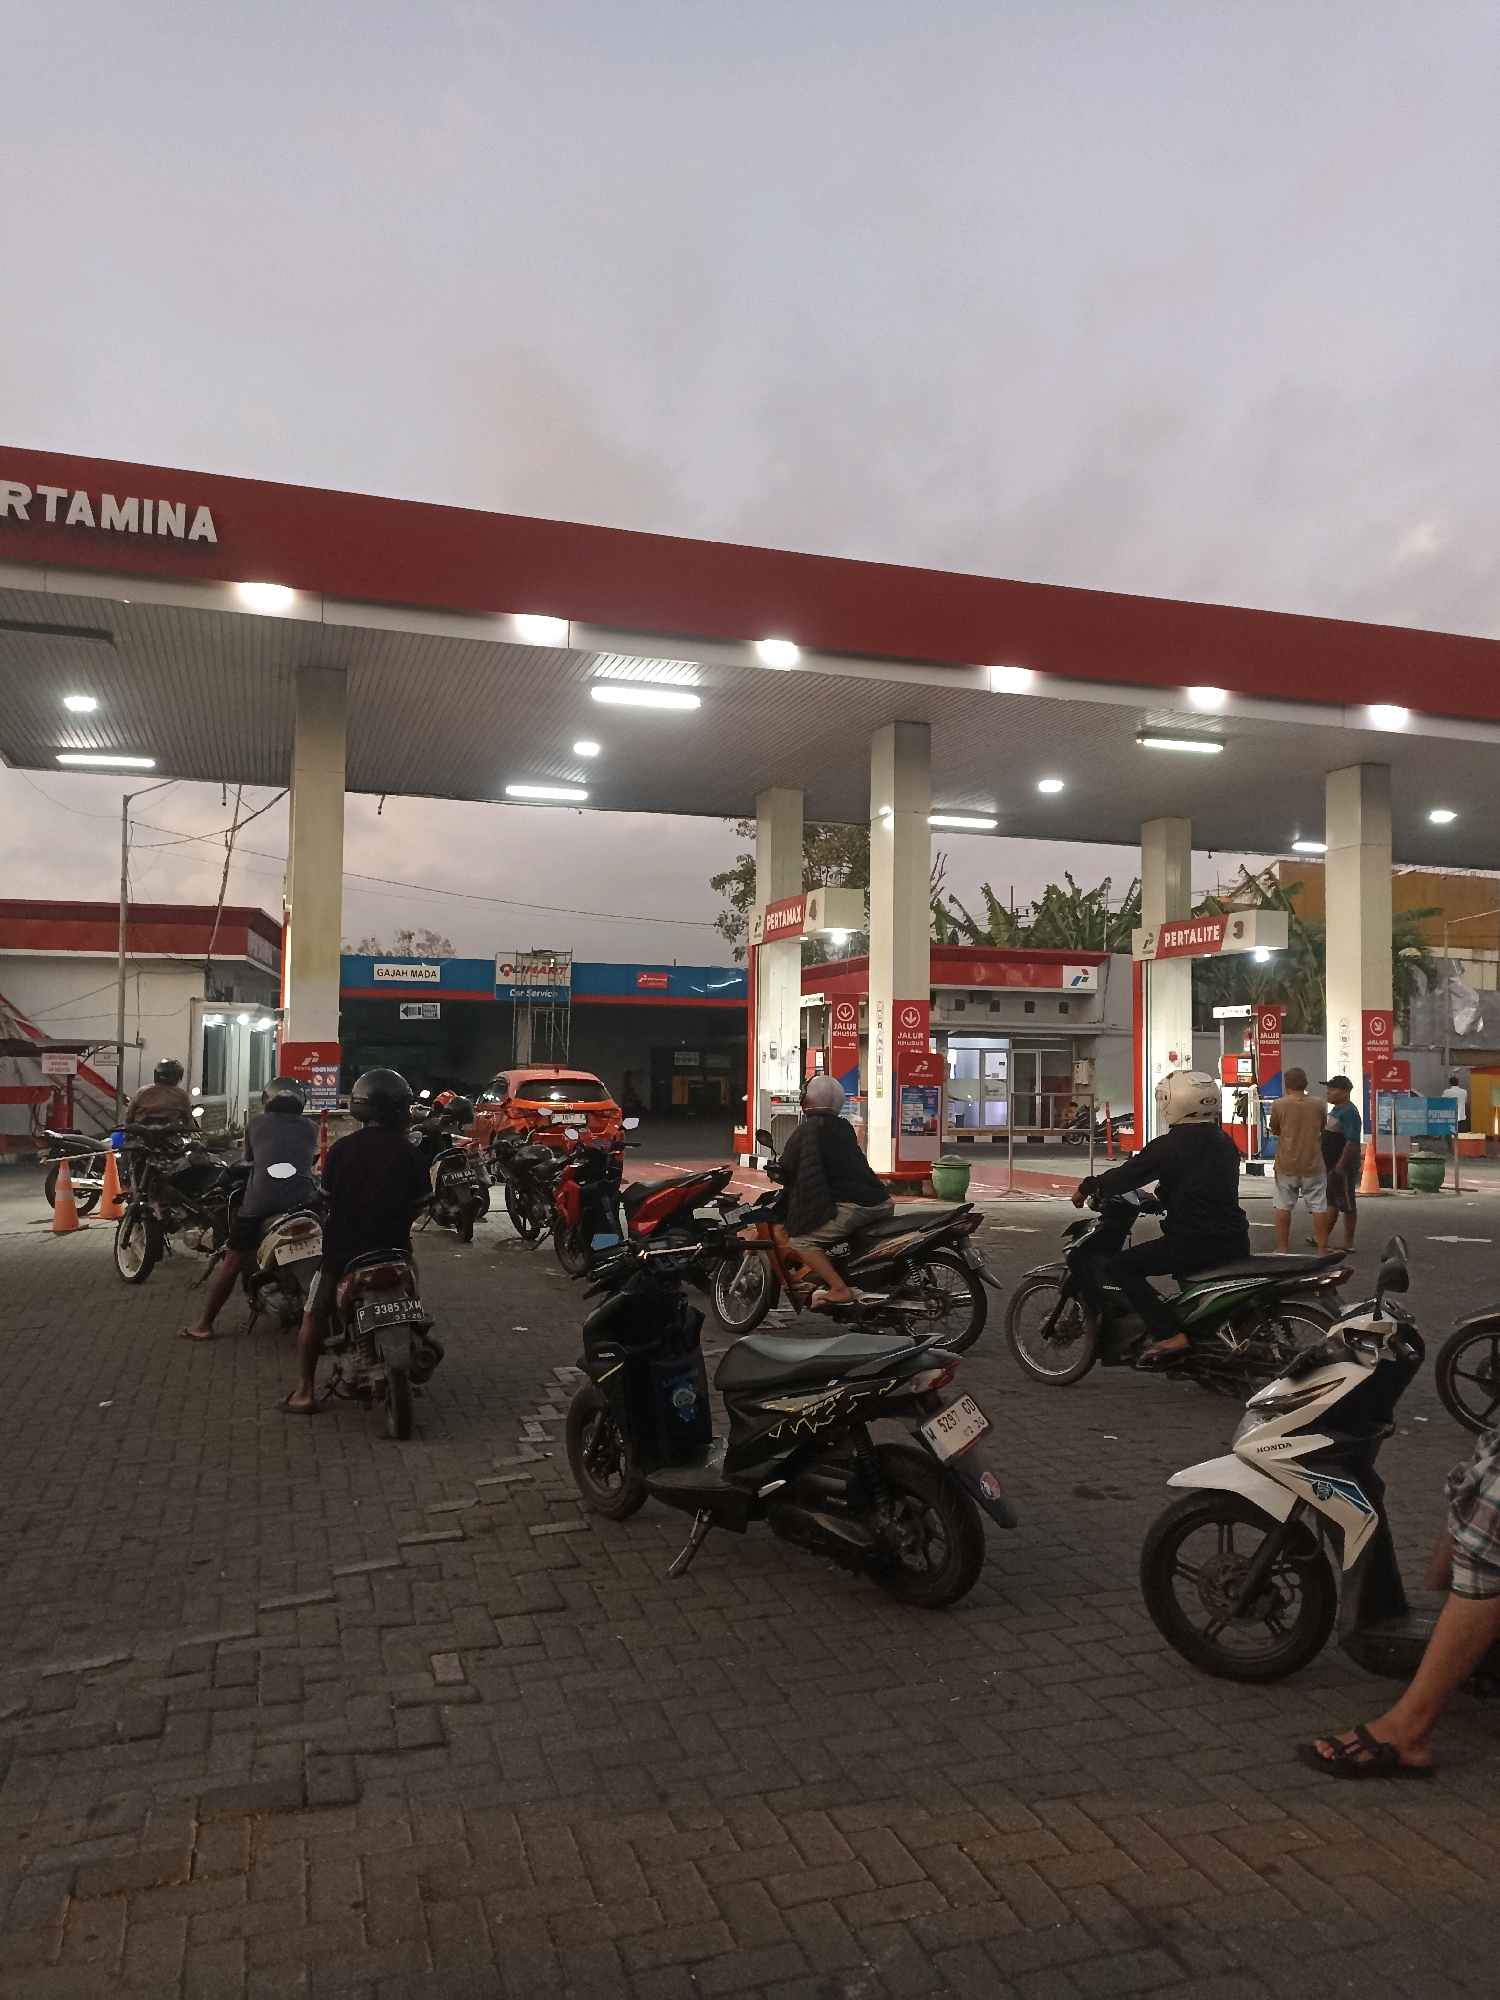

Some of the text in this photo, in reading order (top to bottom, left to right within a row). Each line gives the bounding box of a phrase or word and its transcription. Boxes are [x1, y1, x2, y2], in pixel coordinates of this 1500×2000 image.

[0, 480, 218, 543] RTAMINA
[766, 905, 801, 931] PERTAMAX
[1164, 925, 1220, 948] PERTALITE
[1233, 920, 1244, 939] 3
[377, 968, 437, 979] GAJAH MADA
[509, 987, 558, 998] Car Service
[833, 1023, 857, 1031] JALUR
[360, 1310, 365, 1320] P
[374, 1302, 400, 1315] 3385
[936, 1409, 960, 1433] 5297
[1256, 1442, 1293, 1454] HONDA
